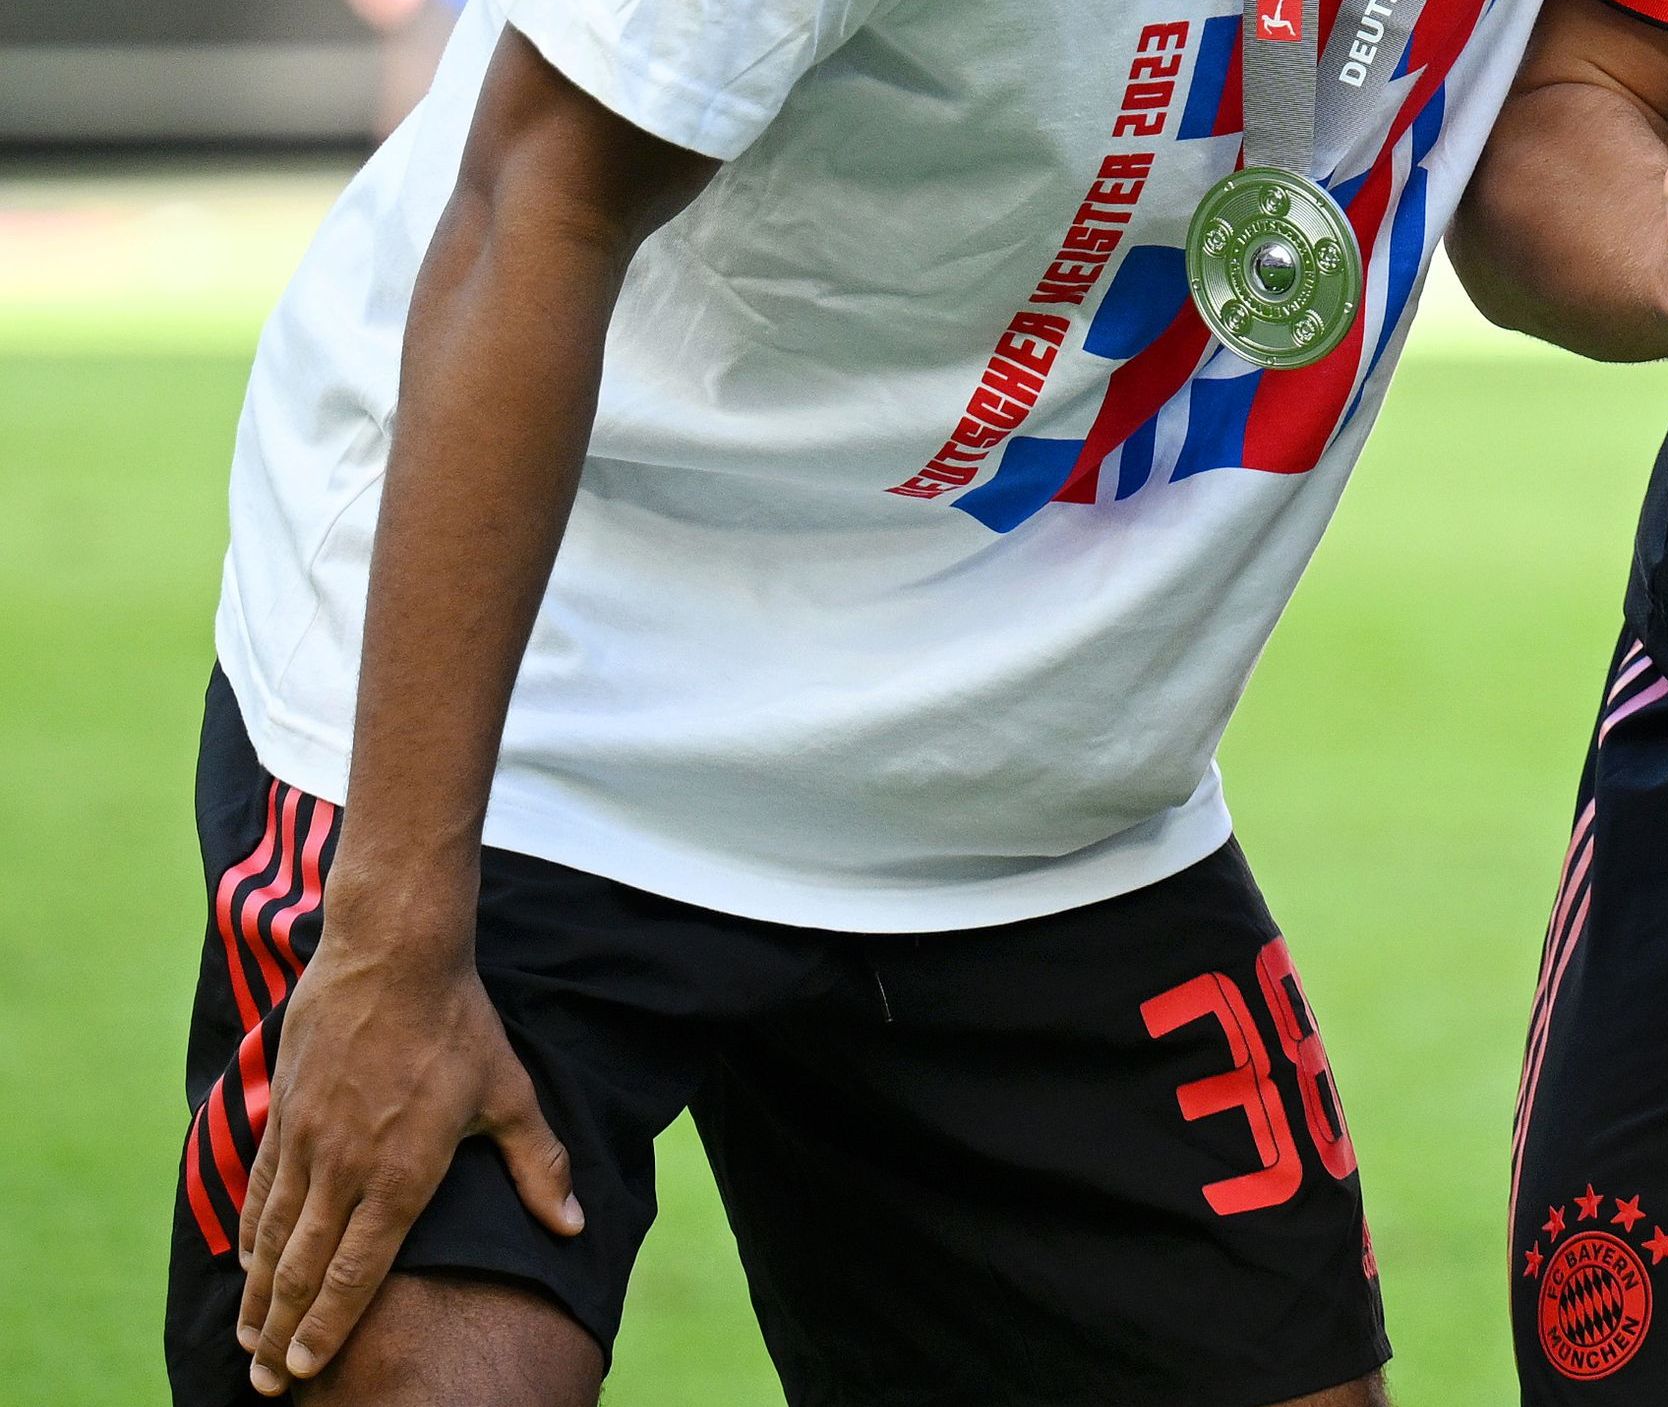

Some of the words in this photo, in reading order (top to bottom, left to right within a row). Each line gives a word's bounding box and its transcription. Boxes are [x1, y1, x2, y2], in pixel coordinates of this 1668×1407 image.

[1029, 153, 1155, 305] MEISTER
[1112, 21, 1189, 137] 2023
[1139, 935, 1357, 1216] 38
[1547, 1269, 1565, 1301] FC
[1565, 1243, 1640, 1292] BAYERN
